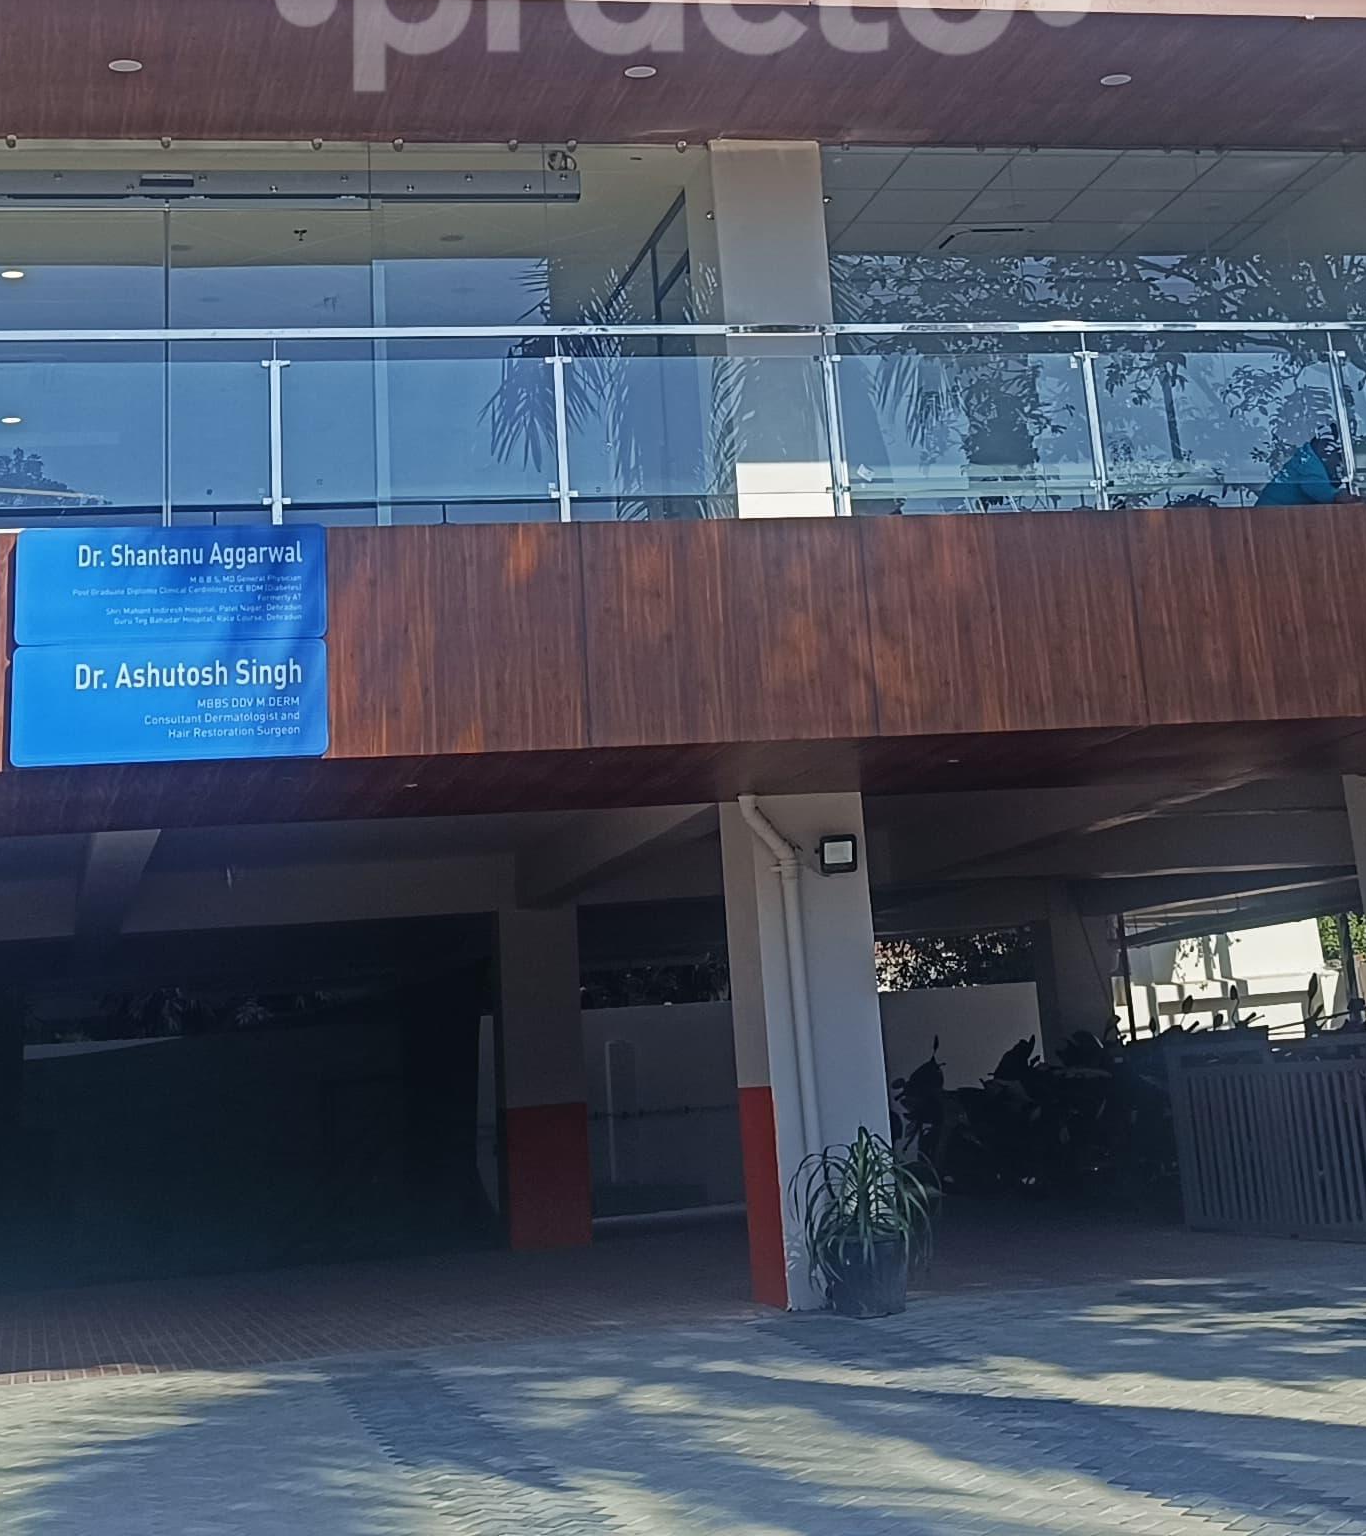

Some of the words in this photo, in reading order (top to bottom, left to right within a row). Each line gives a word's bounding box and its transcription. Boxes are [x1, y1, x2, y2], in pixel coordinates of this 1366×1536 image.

[78, 545, 105, 567] Dr.
[111, 544, 203, 566] Shantanu
[209, 540, 303, 570] Aggarwal
[75, 664, 107, 690] Dr.
[115, 660, 227, 688] Ashutosh
[236, 658, 302, 690] Singh
[197, 699, 228, 709] MBBS
[144, 715, 201, 725] Consultant
[204, 713, 278, 724] Dermatologist
[169, 729, 189, 739] Hair
[194, 727, 254, 738] Restoration
[257, 725, 300, 736] Surgeon
